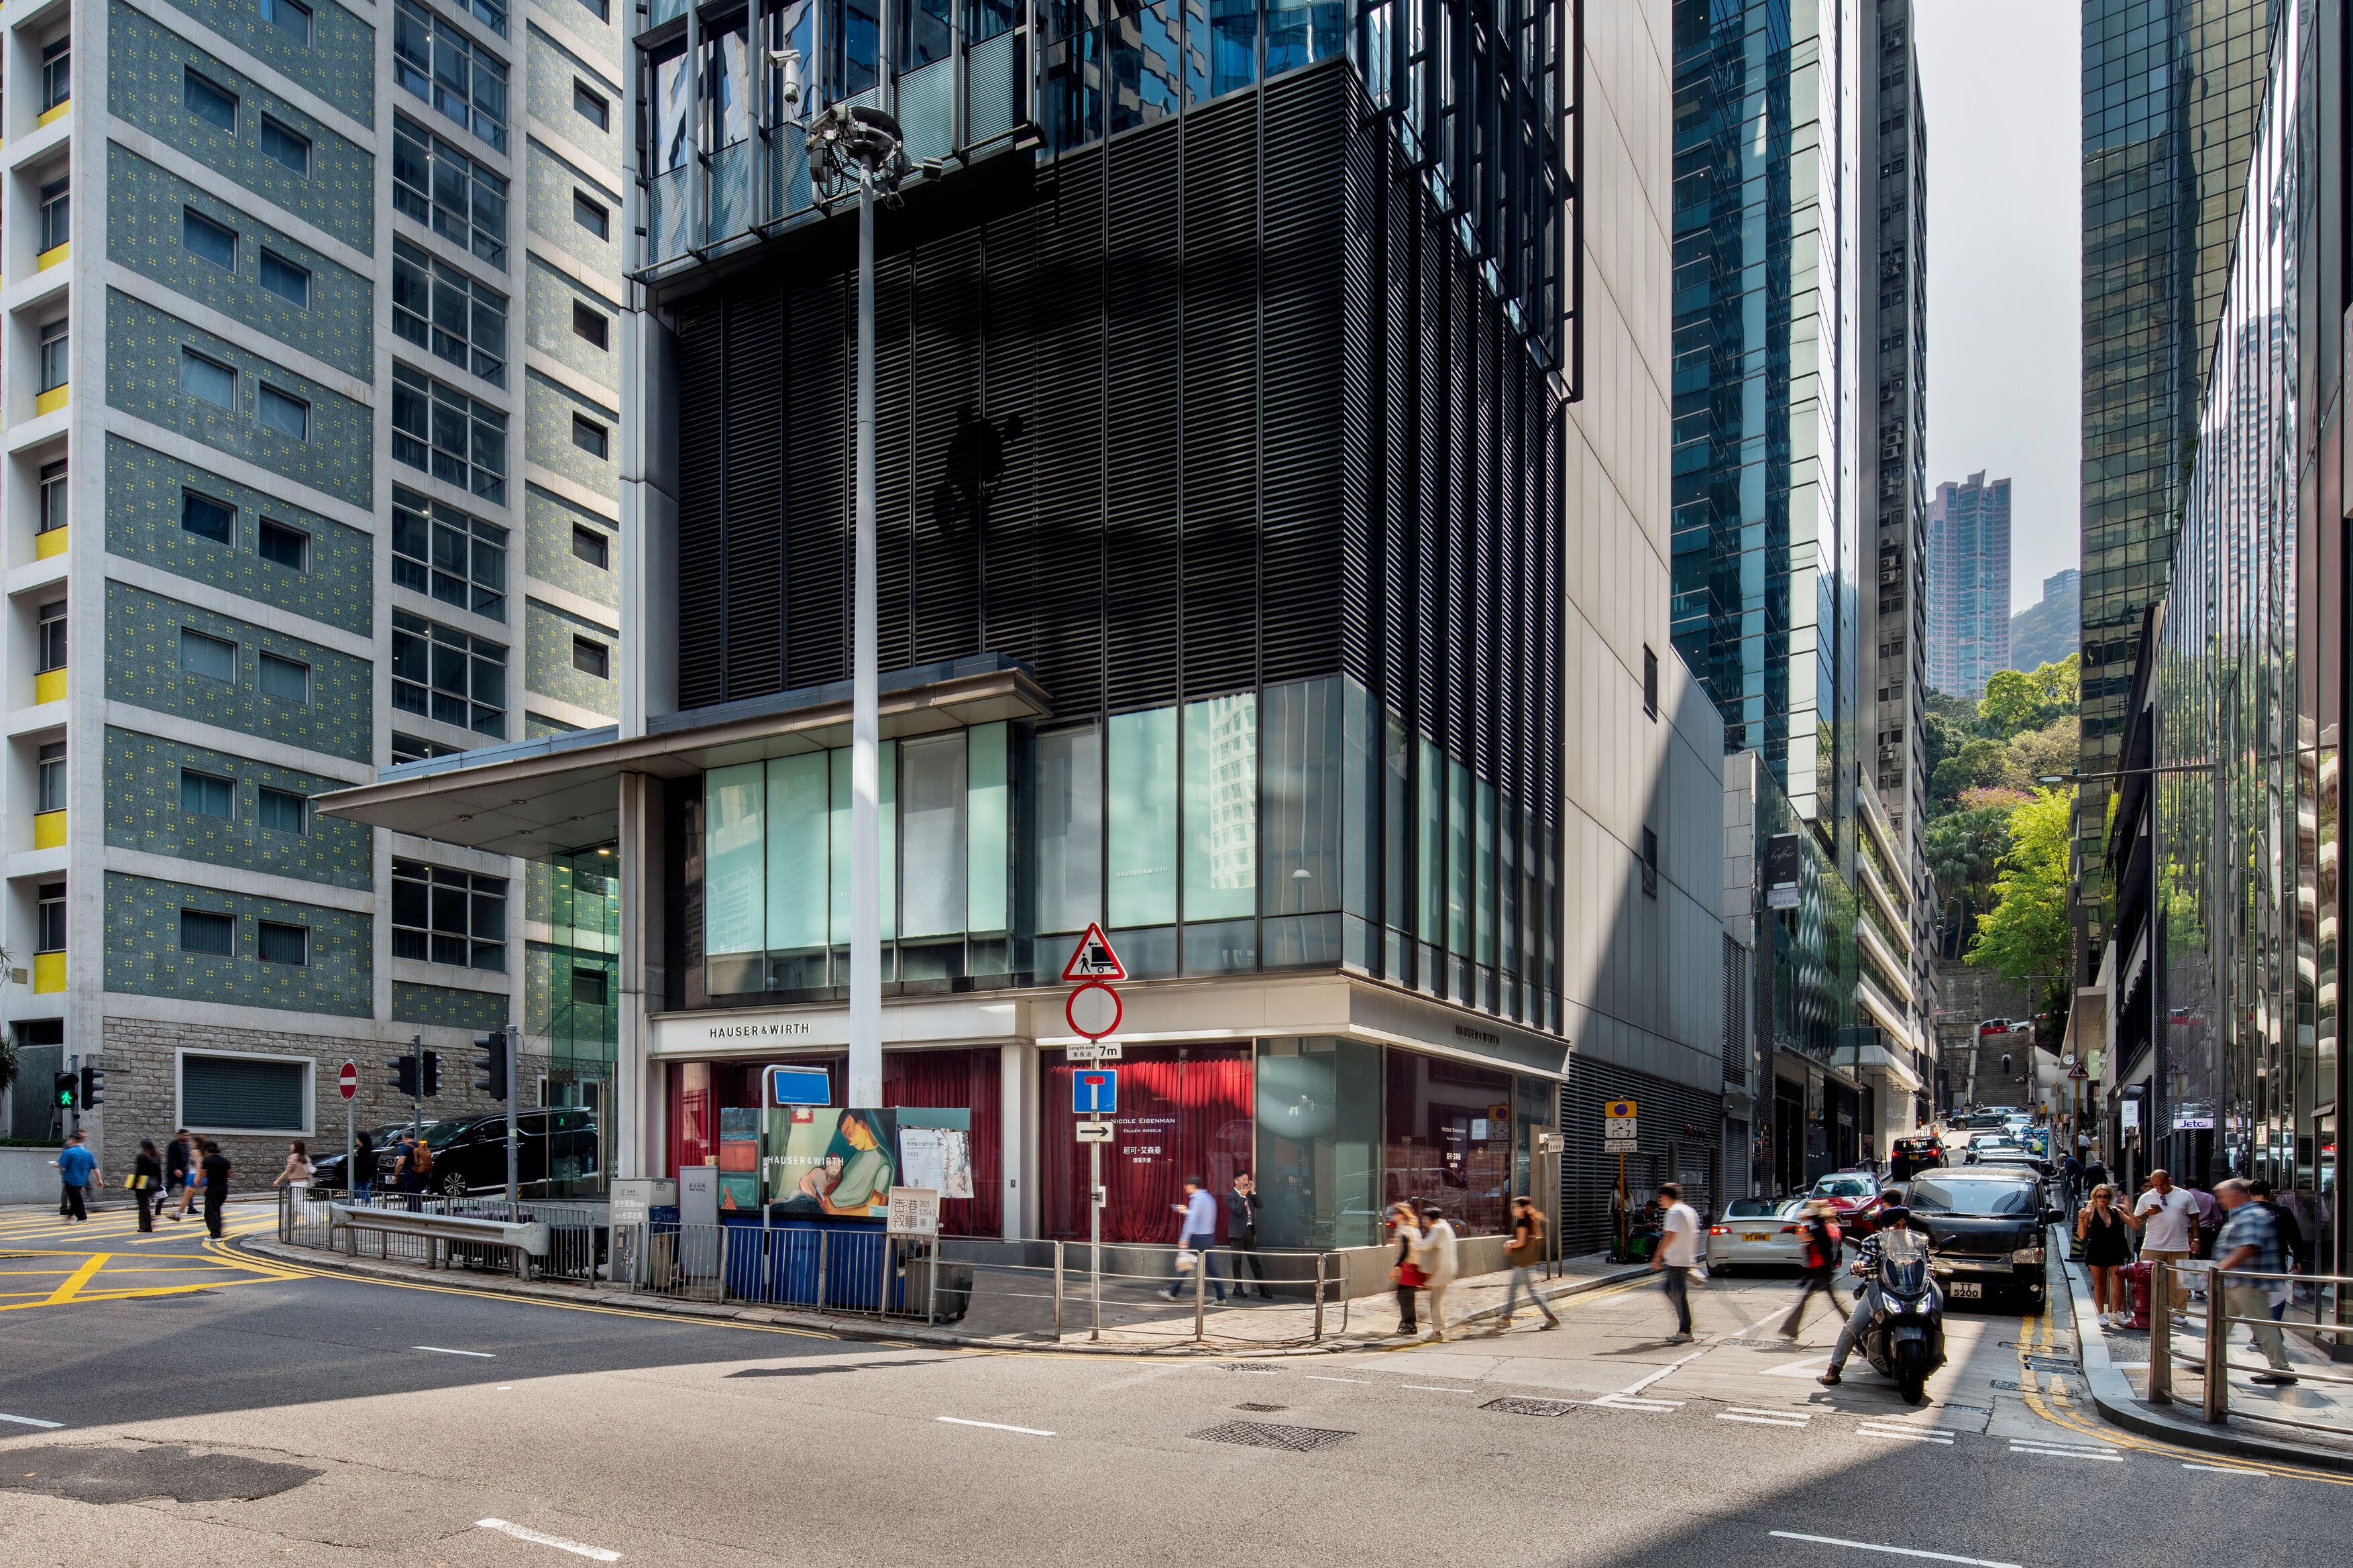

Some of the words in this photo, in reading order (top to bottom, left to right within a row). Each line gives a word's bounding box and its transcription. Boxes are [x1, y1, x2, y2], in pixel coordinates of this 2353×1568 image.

[1769, 846, 1795, 867] beefbar
[1099, 1046, 1117, 1056] 7m
[893, 1199, 918, 1213] 香港
[1954, 1289, 1978, 1297] 5200
